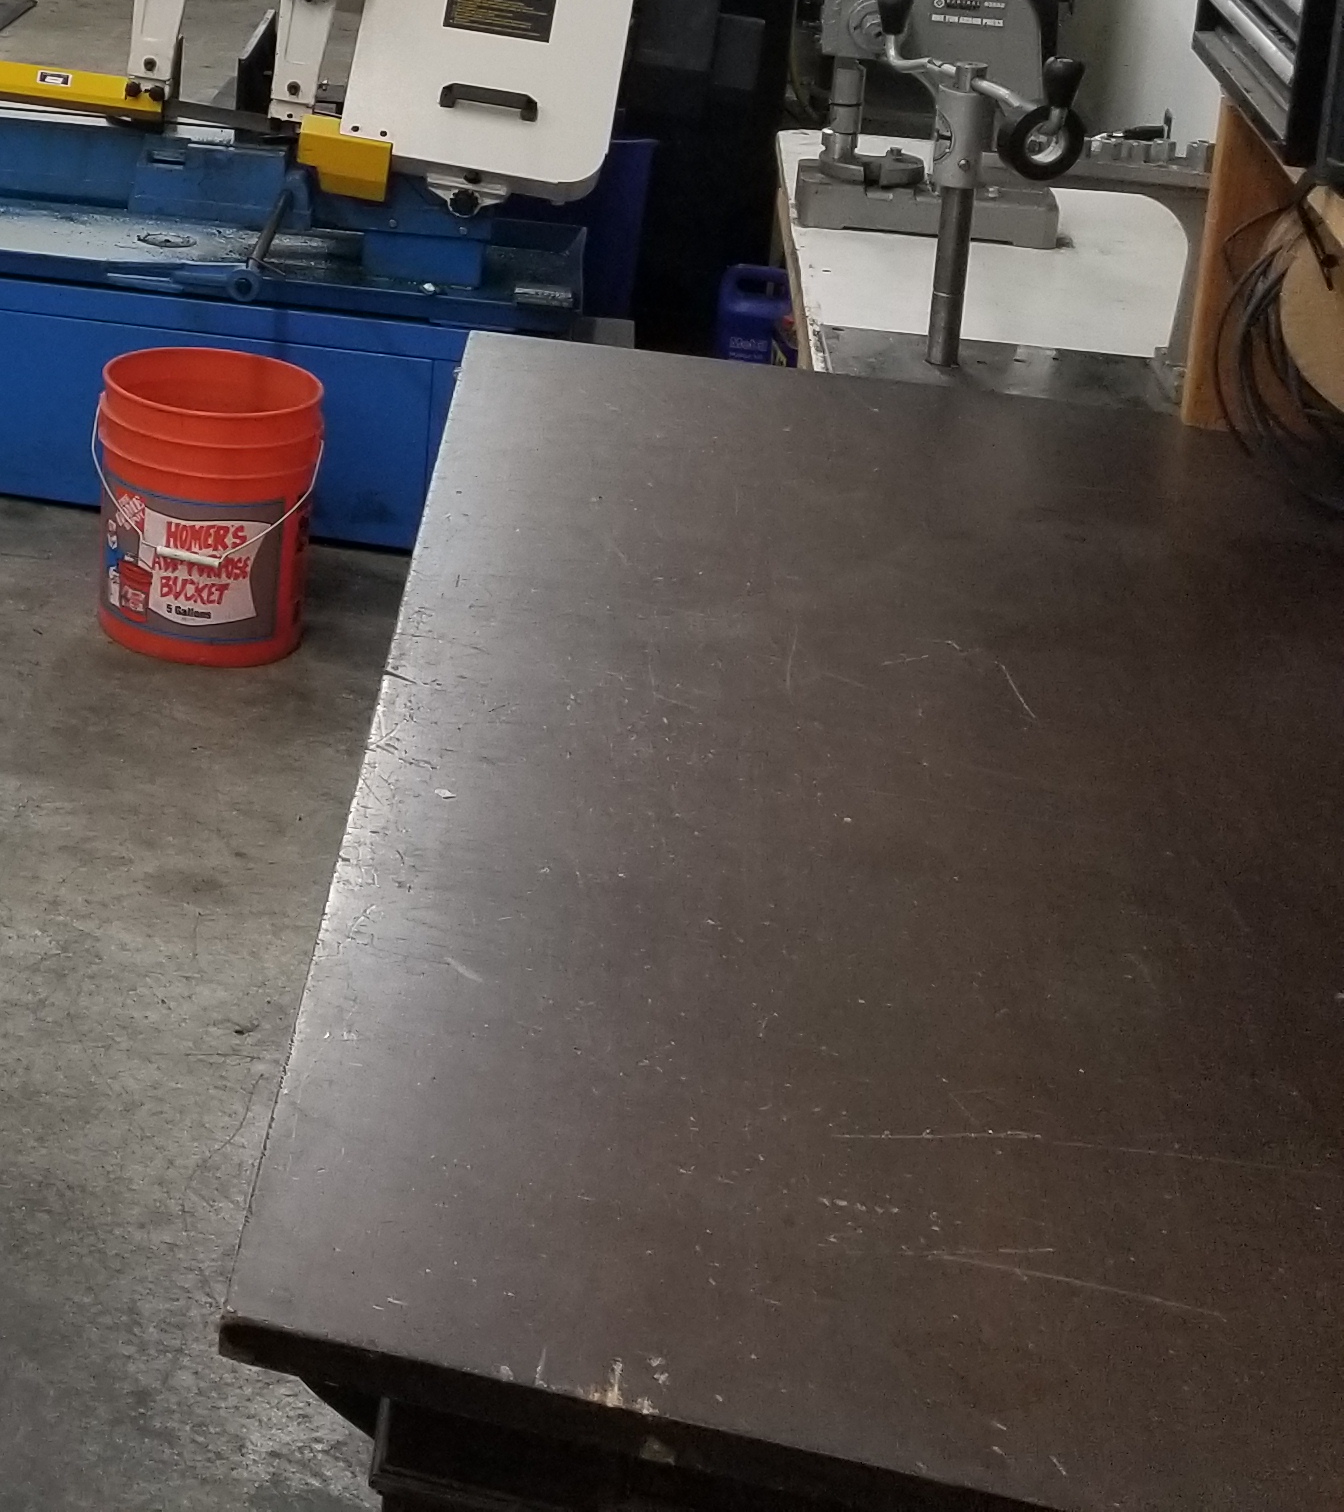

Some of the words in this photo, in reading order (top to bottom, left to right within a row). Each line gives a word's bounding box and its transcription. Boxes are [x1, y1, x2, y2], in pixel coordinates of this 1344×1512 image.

[166, 521, 248, 551] HOMER'S
[160, 576, 230, 605] BUCKET
[166, 604, 172, 614] 5
[174, 606, 212, 620] Gallons
